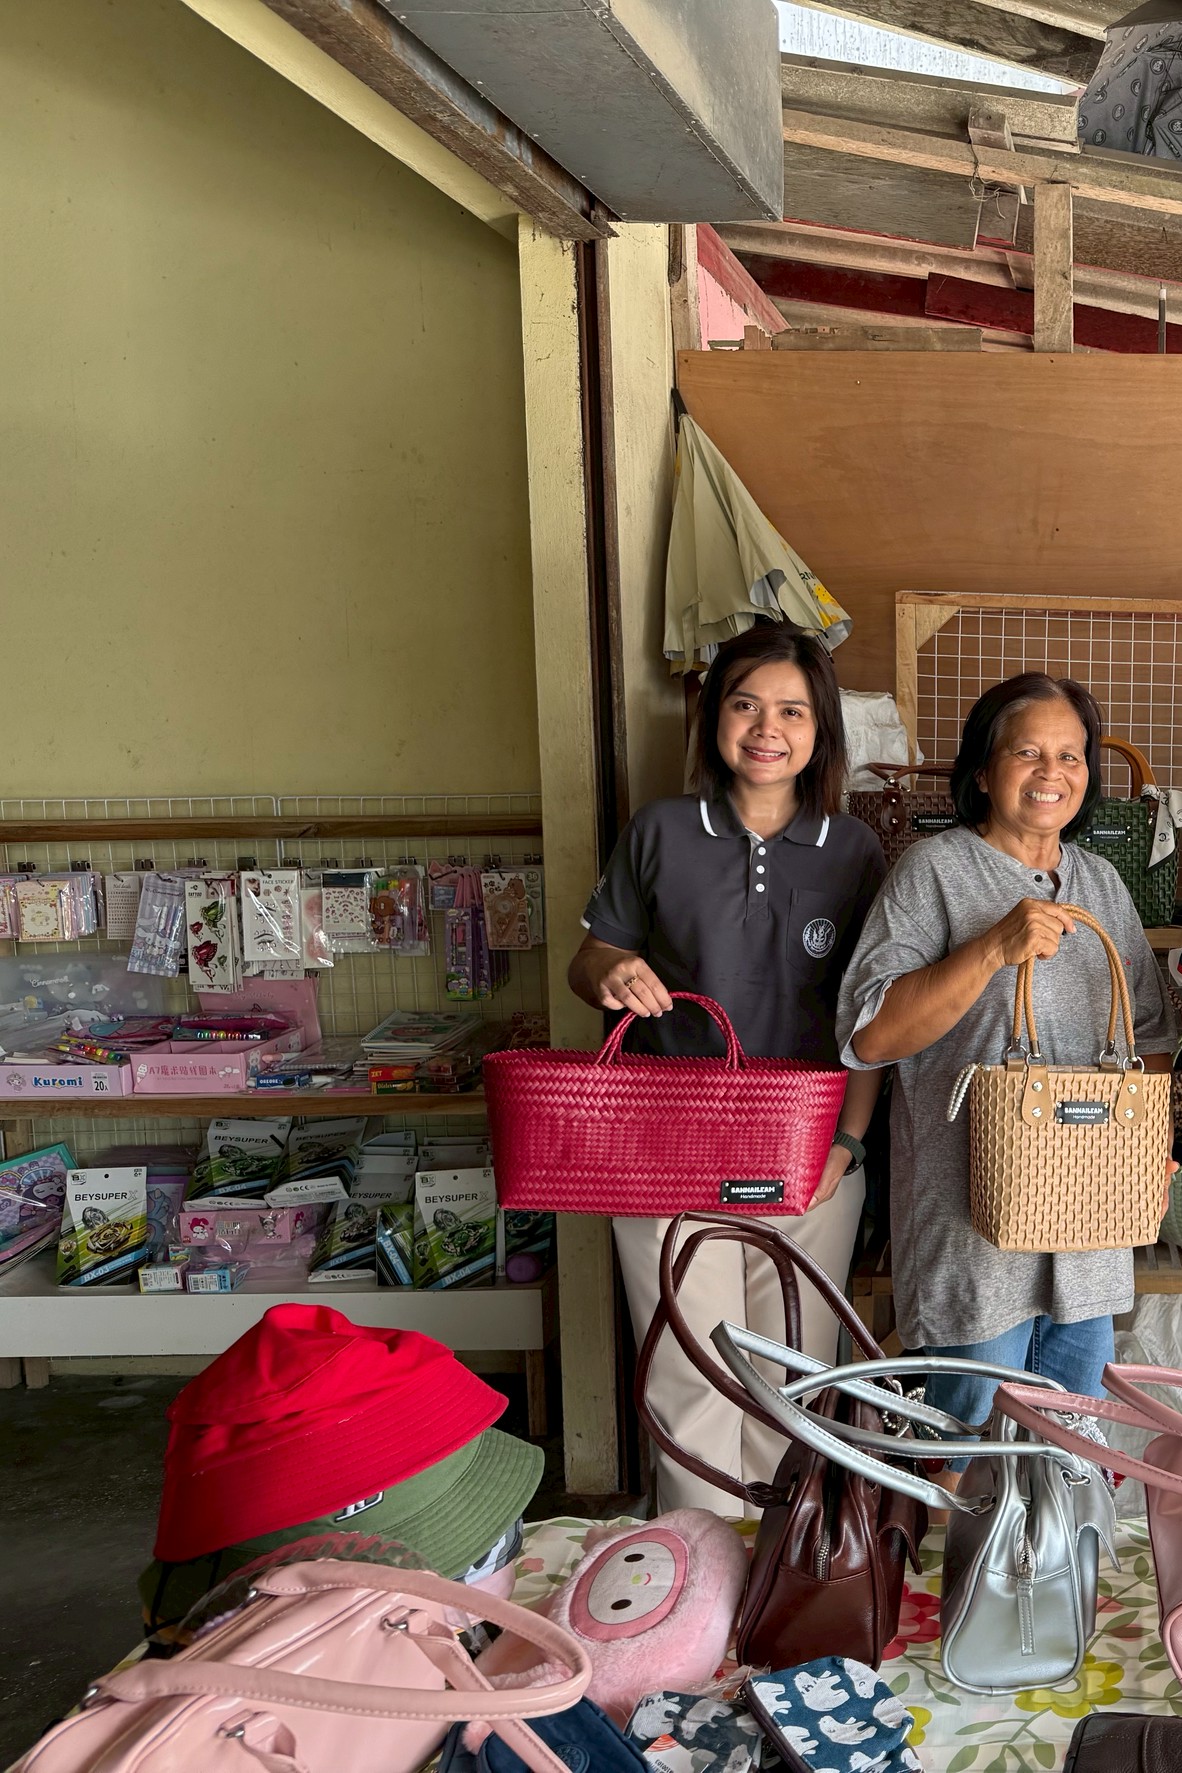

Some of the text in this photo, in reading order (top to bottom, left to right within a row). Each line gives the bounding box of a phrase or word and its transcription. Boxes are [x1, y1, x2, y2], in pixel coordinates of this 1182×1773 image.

[33, 1076, 83, 1087] Kuromi
[214, 1135, 269, 1144] BEYSUPER
[731, 1186, 776, 1194] BANNAILEAM
[74, 1192, 128, 1201] BEYSUPER
[424, 1193, 478, 1204] BEYSUPER
[82, 1265, 111, 1282] BX-03
